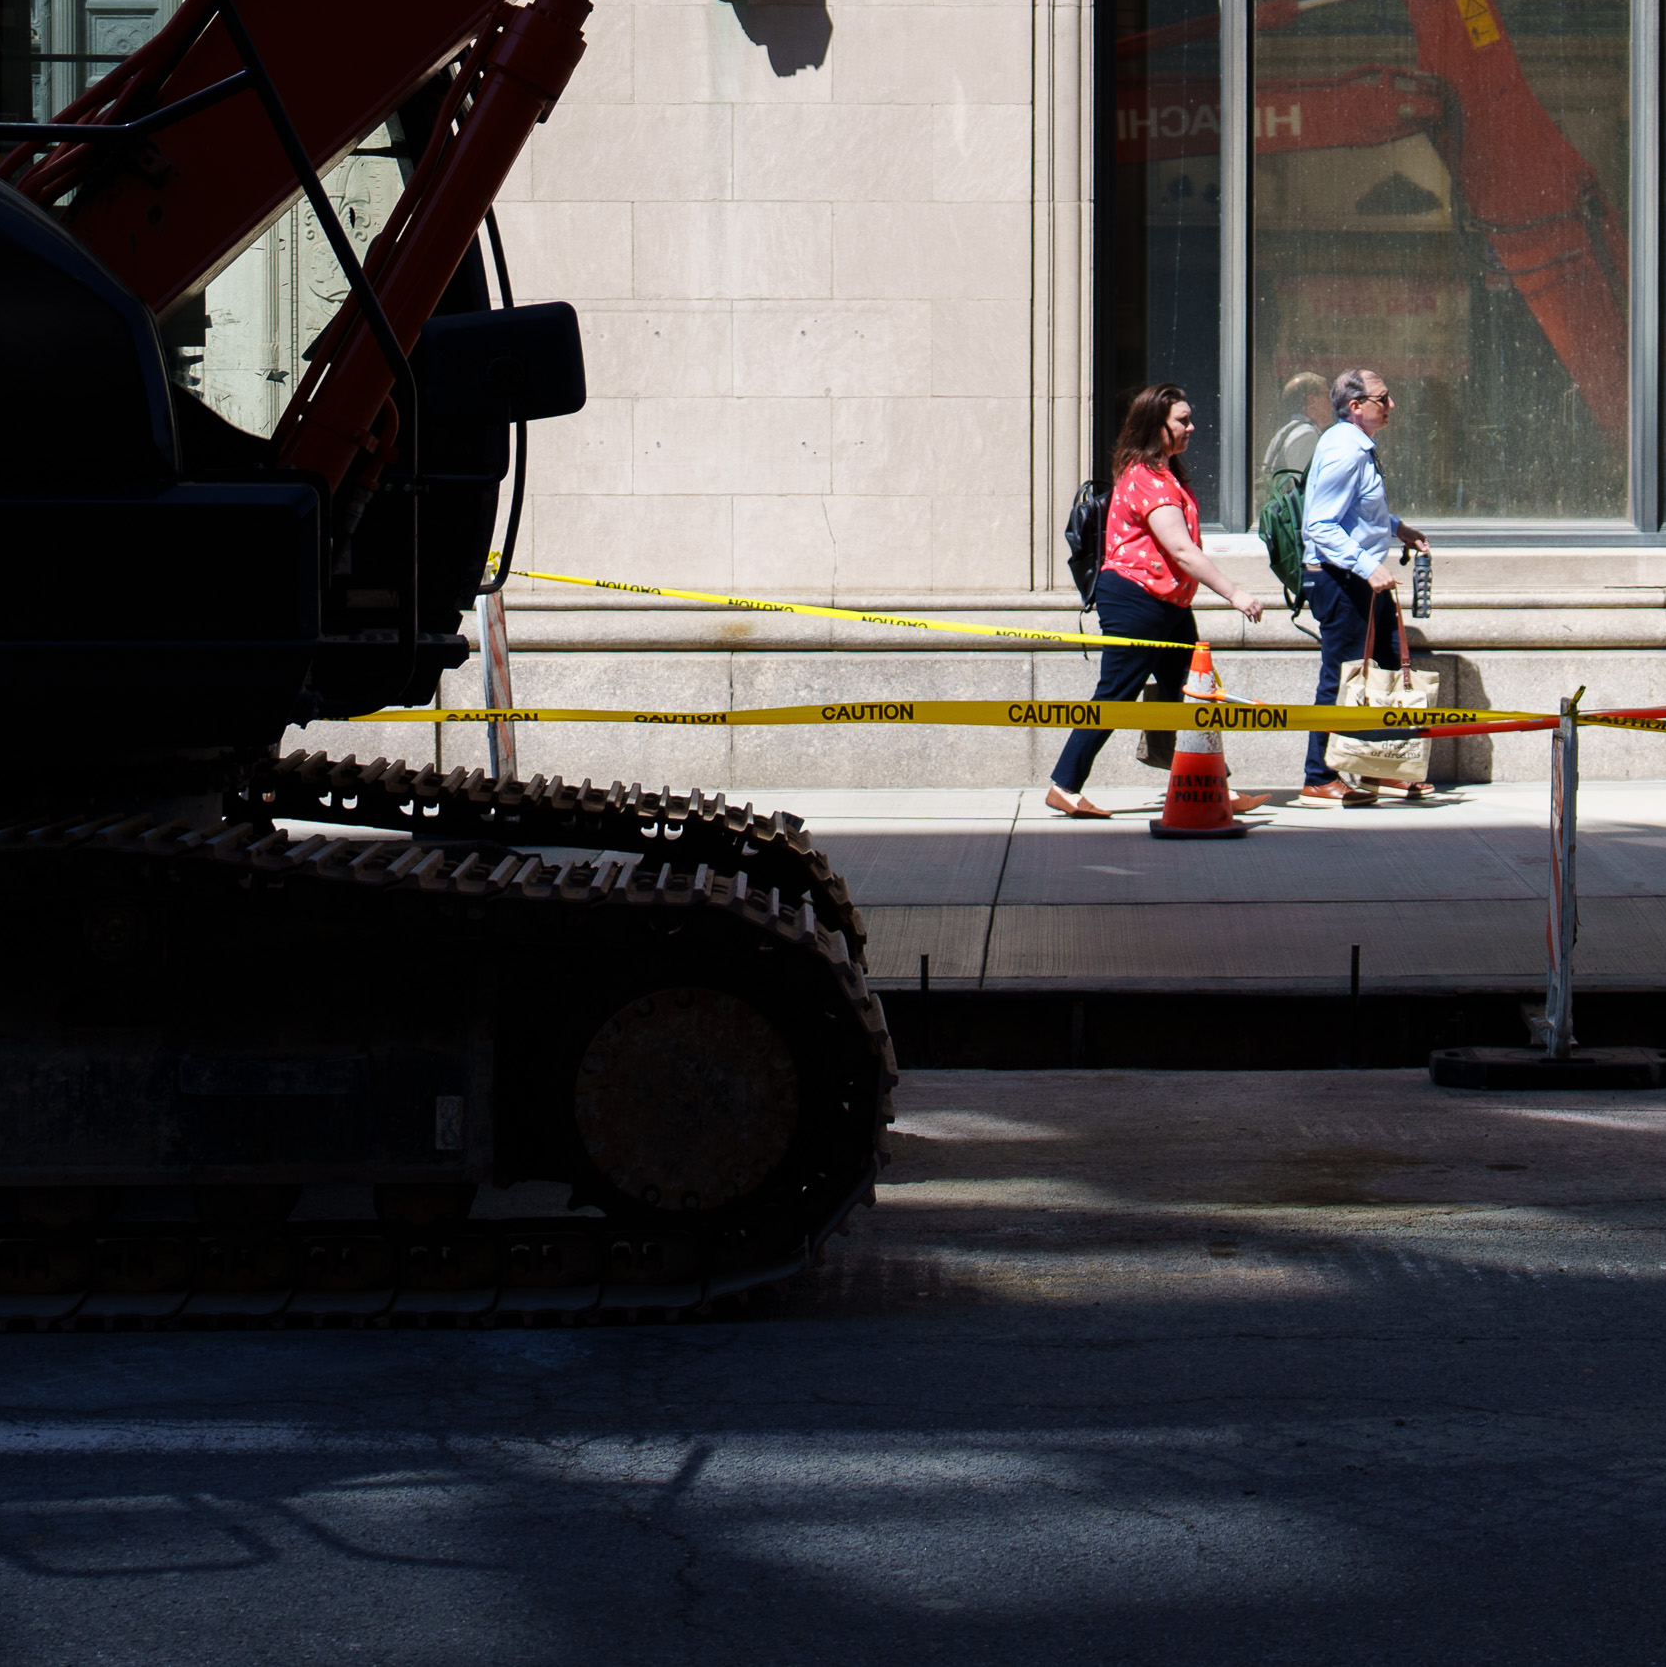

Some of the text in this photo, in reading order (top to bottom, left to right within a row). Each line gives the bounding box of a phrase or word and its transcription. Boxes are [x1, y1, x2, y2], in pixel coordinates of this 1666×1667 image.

[634, 714, 727, 724] CAUTION
[821, 704, 914, 721] CAUTION
[1008, 704, 1101, 725] CAUTION
[1194, 707, 1287, 728] CAUTION
[1383, 711, 1476, 726] CAUTION
[1384, 750, 1421, 759] dreams
[1175, 790, 1223, 803] POLICE
